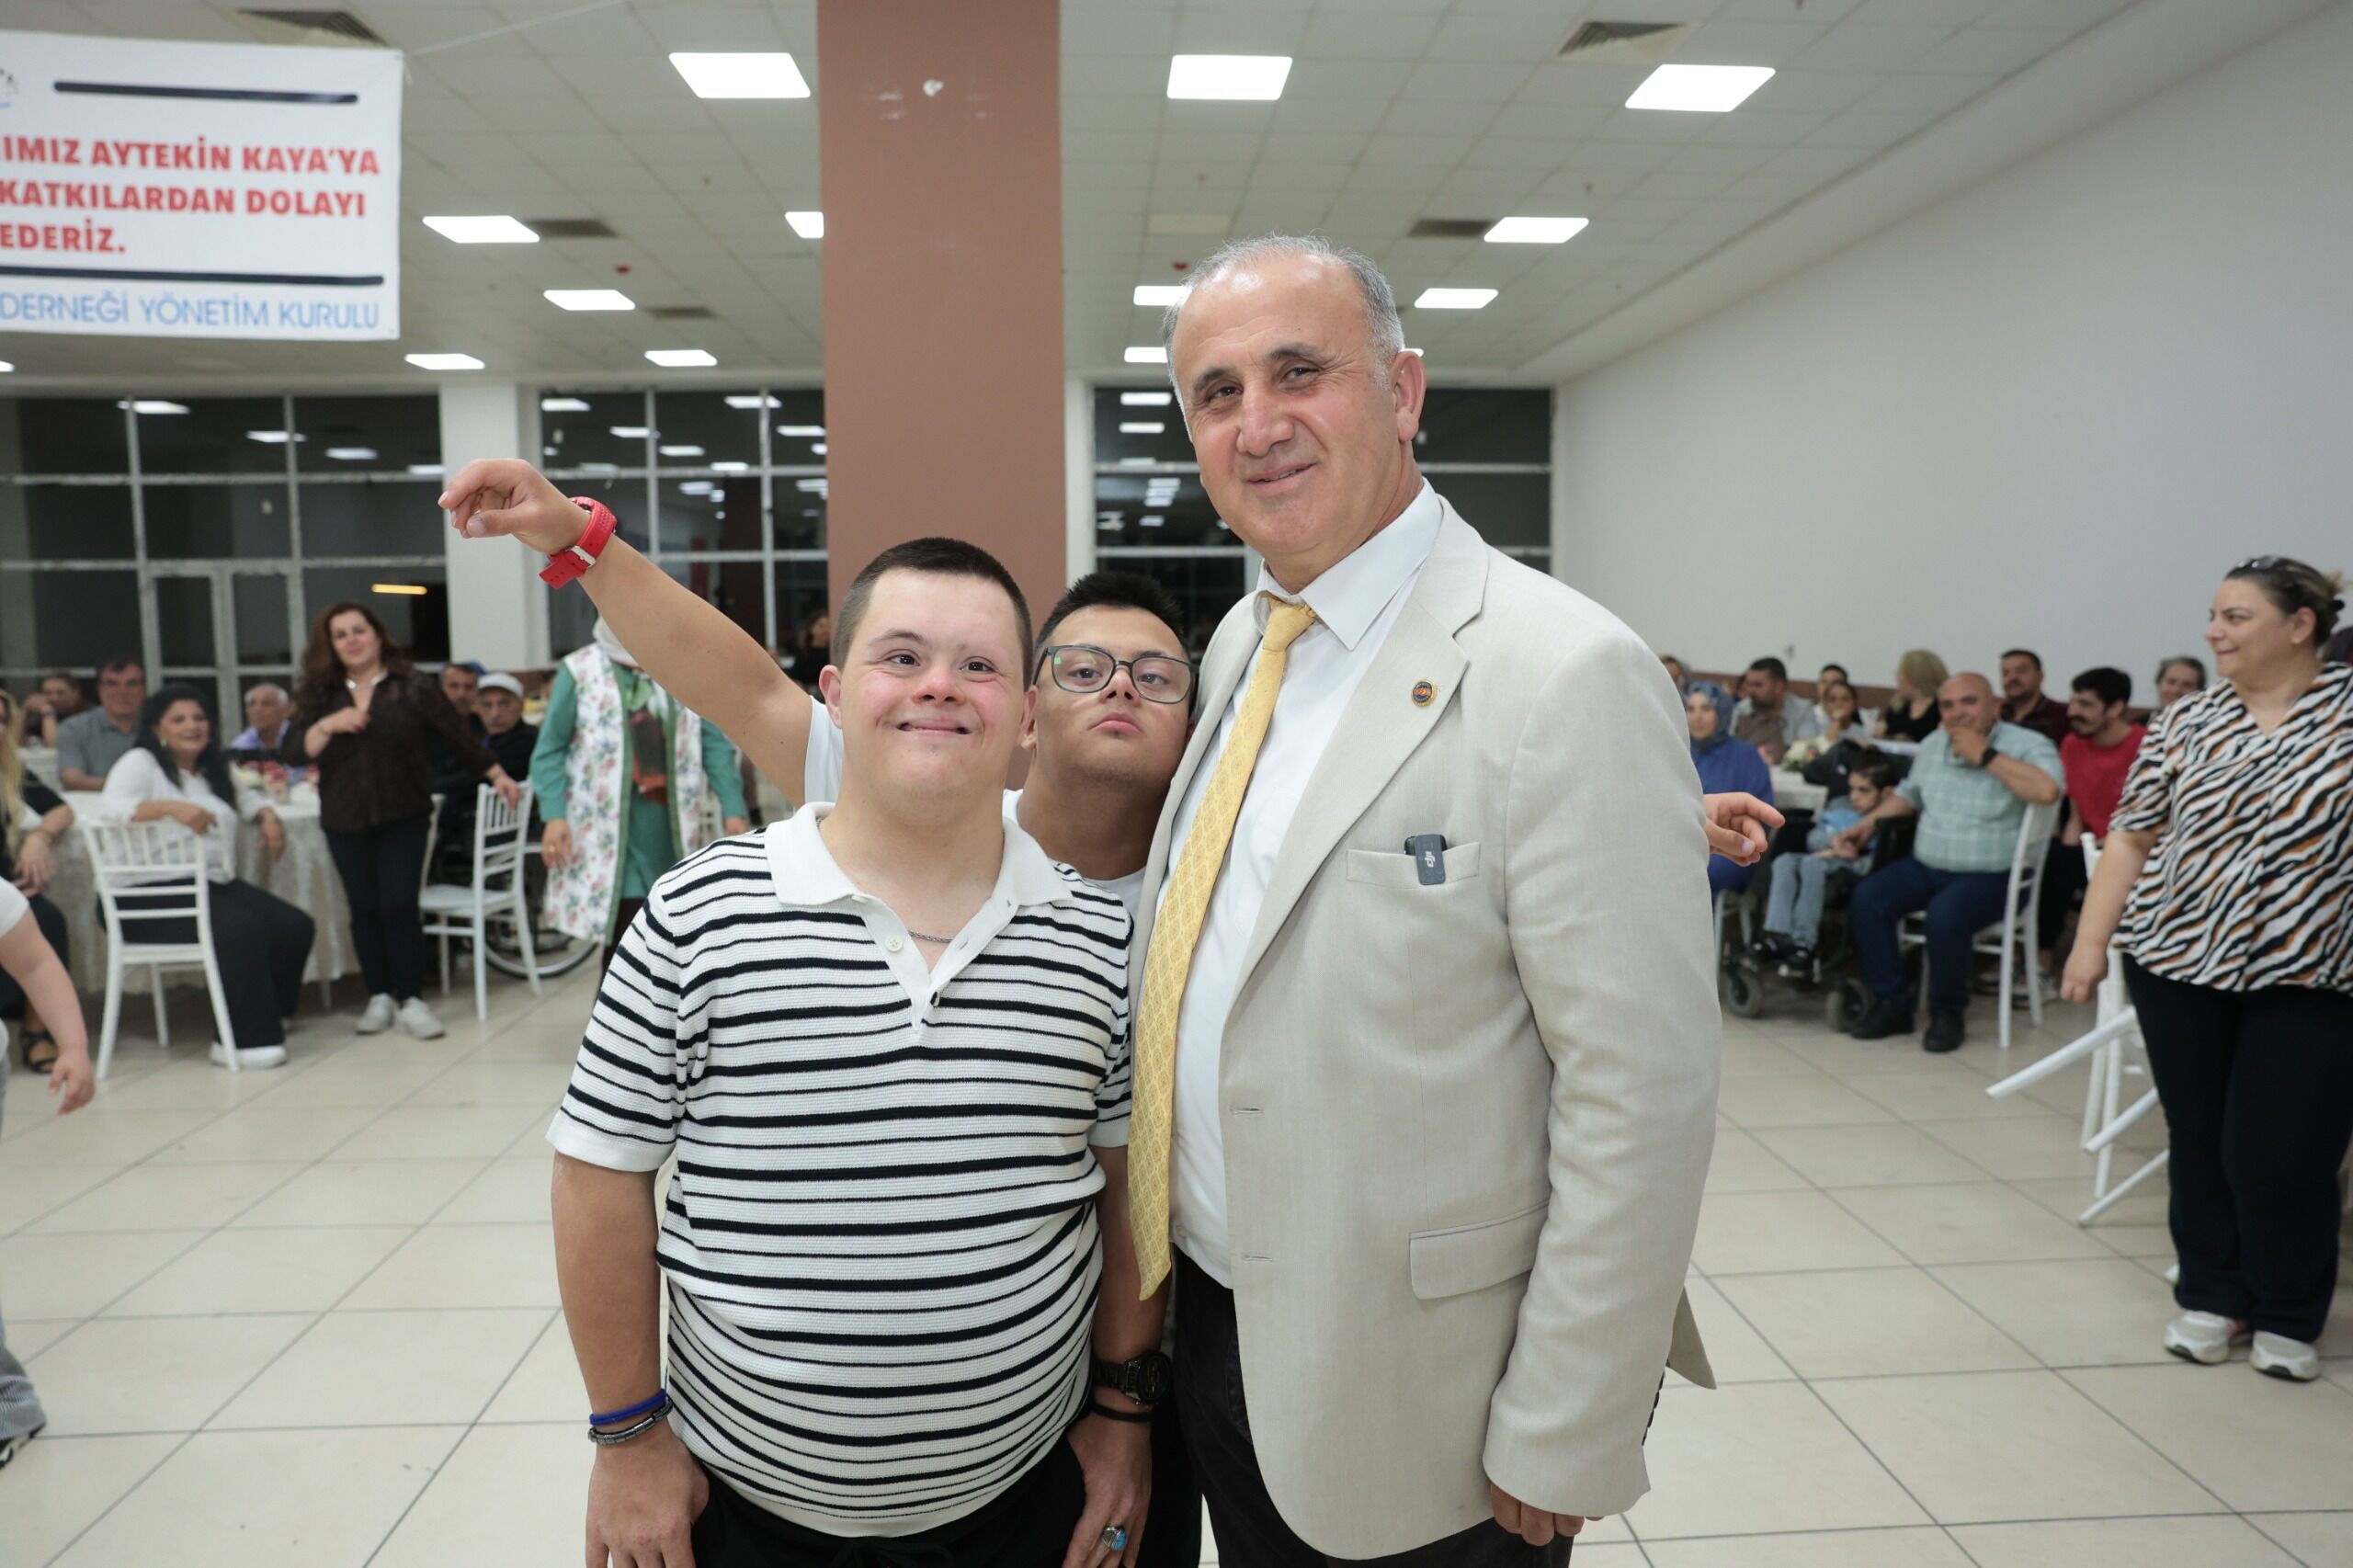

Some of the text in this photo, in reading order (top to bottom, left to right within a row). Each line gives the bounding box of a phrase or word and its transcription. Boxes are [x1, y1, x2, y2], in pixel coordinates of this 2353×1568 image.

[92, 135, 231, 170] AYTEKİN
[243, 146, 380, 174] KAYA'YA
[0, 179, 366, 217] KATKILARDAN DOLAYI
[0, 219, 126, 253] EDERİZ.
[0, 290, 380, 329] DERNEĞİ YÖNETİM KURULU
